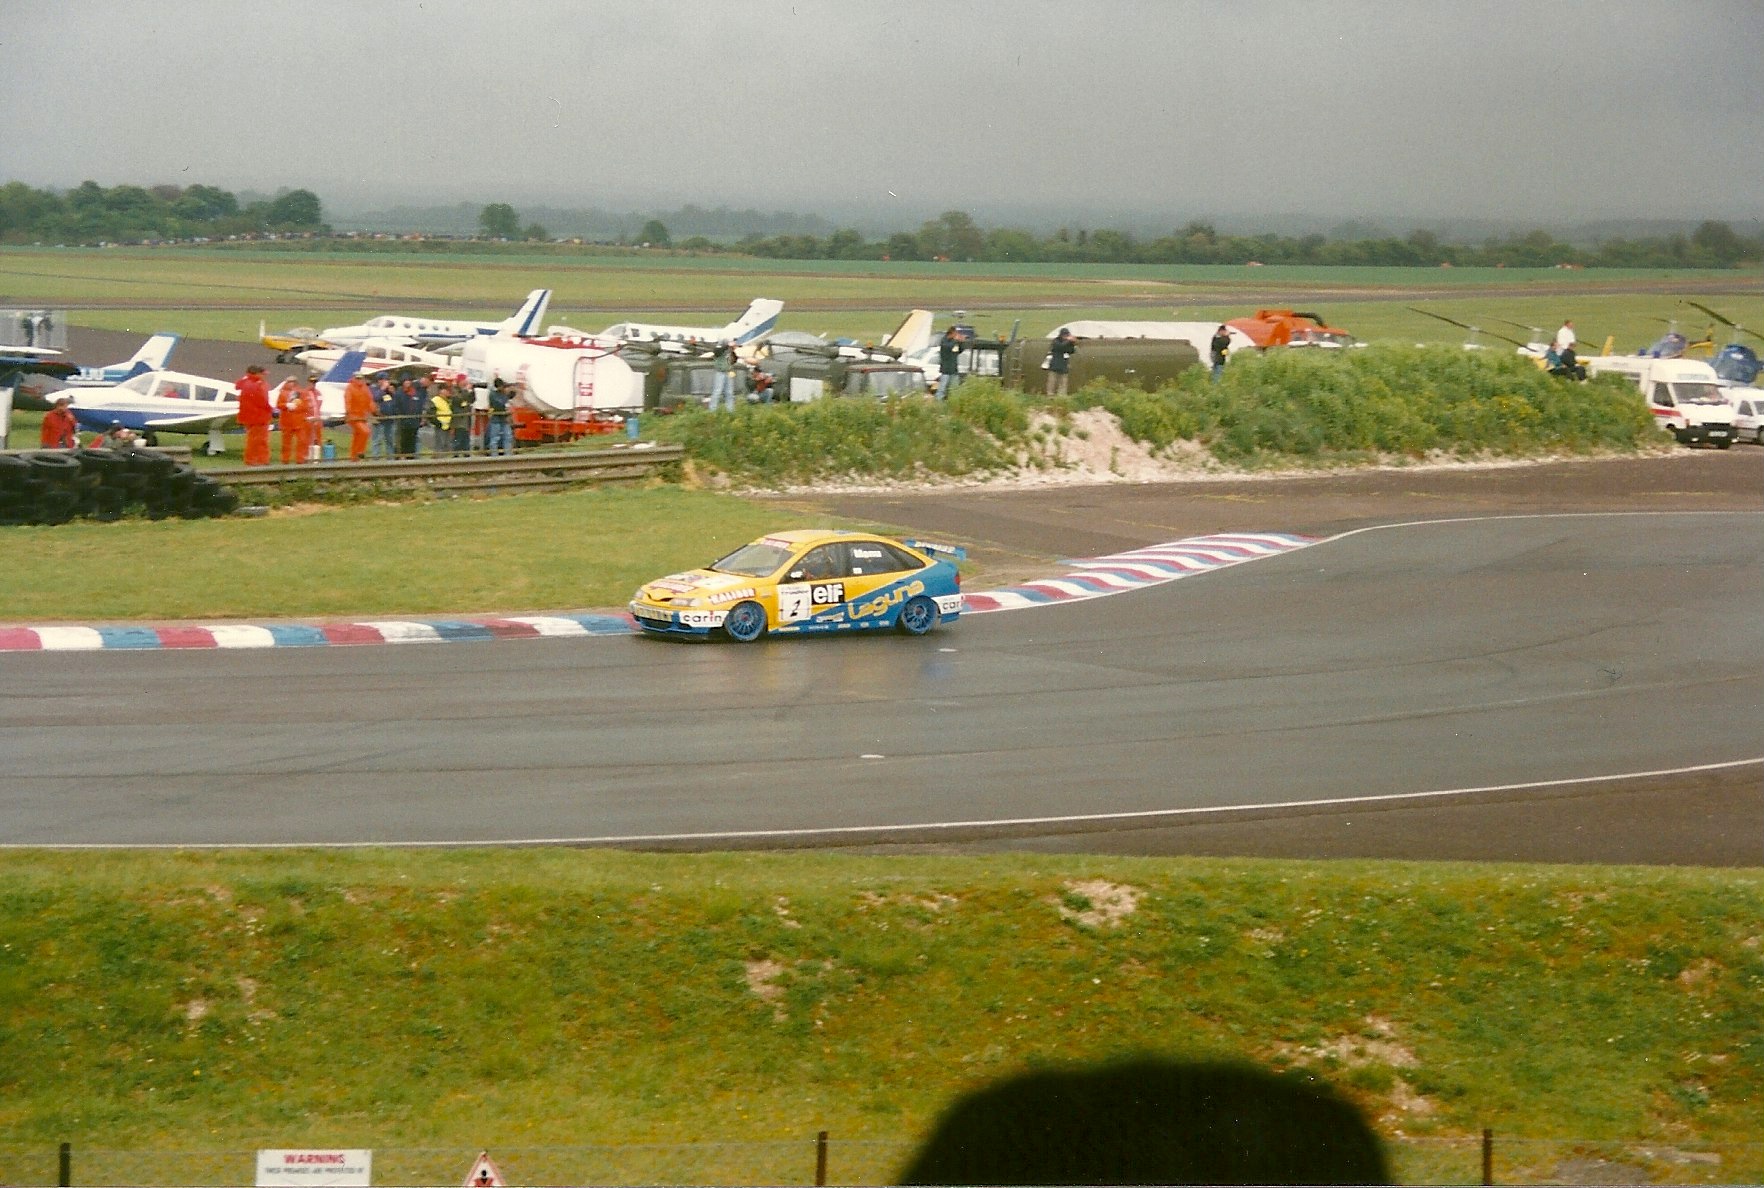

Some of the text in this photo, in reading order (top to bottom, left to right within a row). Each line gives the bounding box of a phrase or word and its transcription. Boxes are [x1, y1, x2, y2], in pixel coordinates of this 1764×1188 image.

[848, 580, 925, 619] Laguna
[682, 610, 723, 623] carin
[284, 1154, 345, 1164] WARNING
